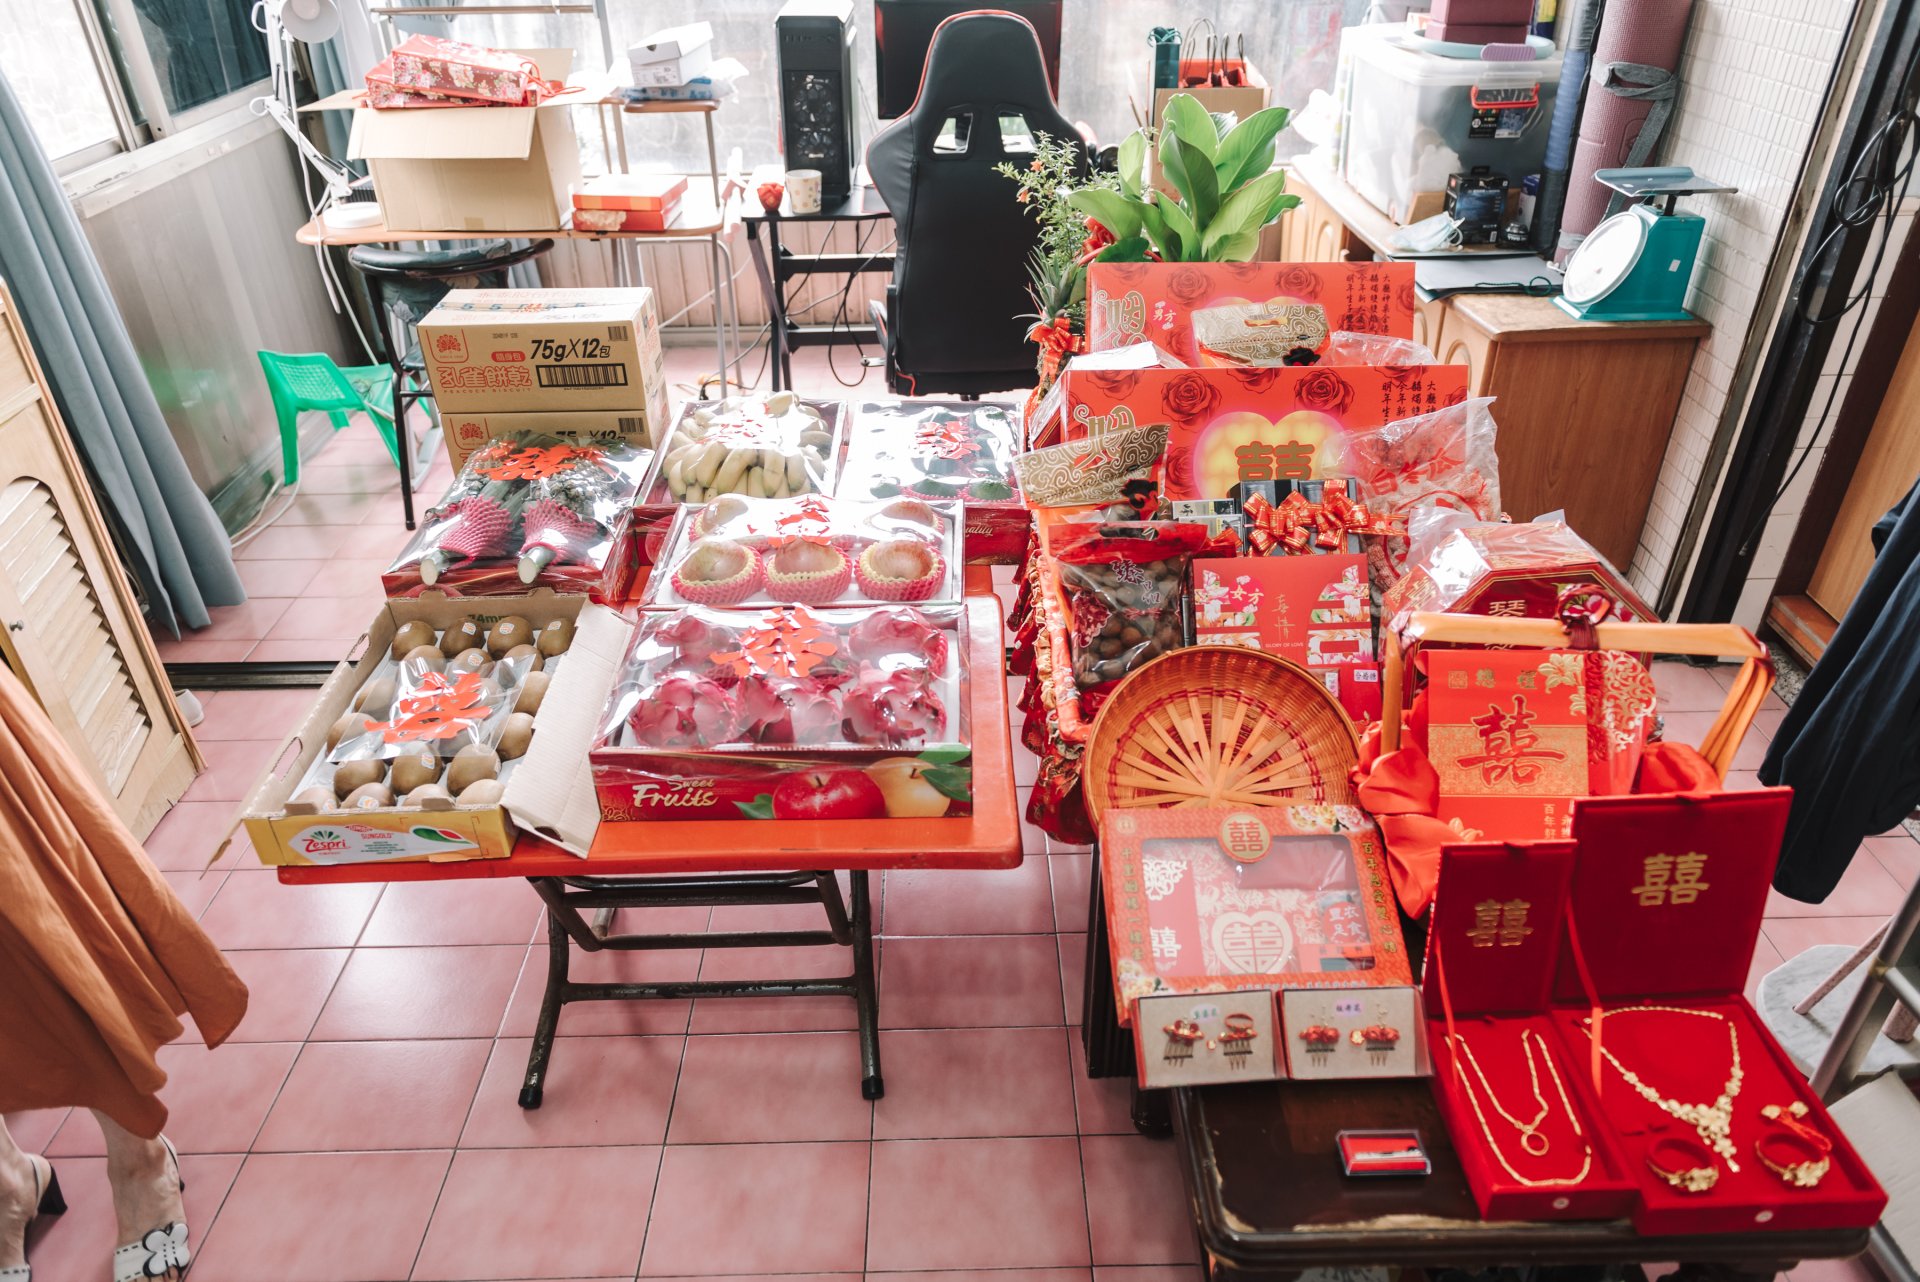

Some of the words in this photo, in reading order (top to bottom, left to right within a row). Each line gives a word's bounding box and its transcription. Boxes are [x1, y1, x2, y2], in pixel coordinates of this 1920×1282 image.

[437, 366, 532, 388] 孔雀餅乾
[965, 522, 993, 537] uality
[1230, 584, 1264, 605] 女方
[667, 774, 714, 791] Sweet
[632, 783, 719, 807] Fruits
[302, 838, 346, 852] Zespri
[1228, 820, 1268, 852] 囍
[1631, 852, 1710, 906] 囍
[1466, 899, 1534, 947] 囍
